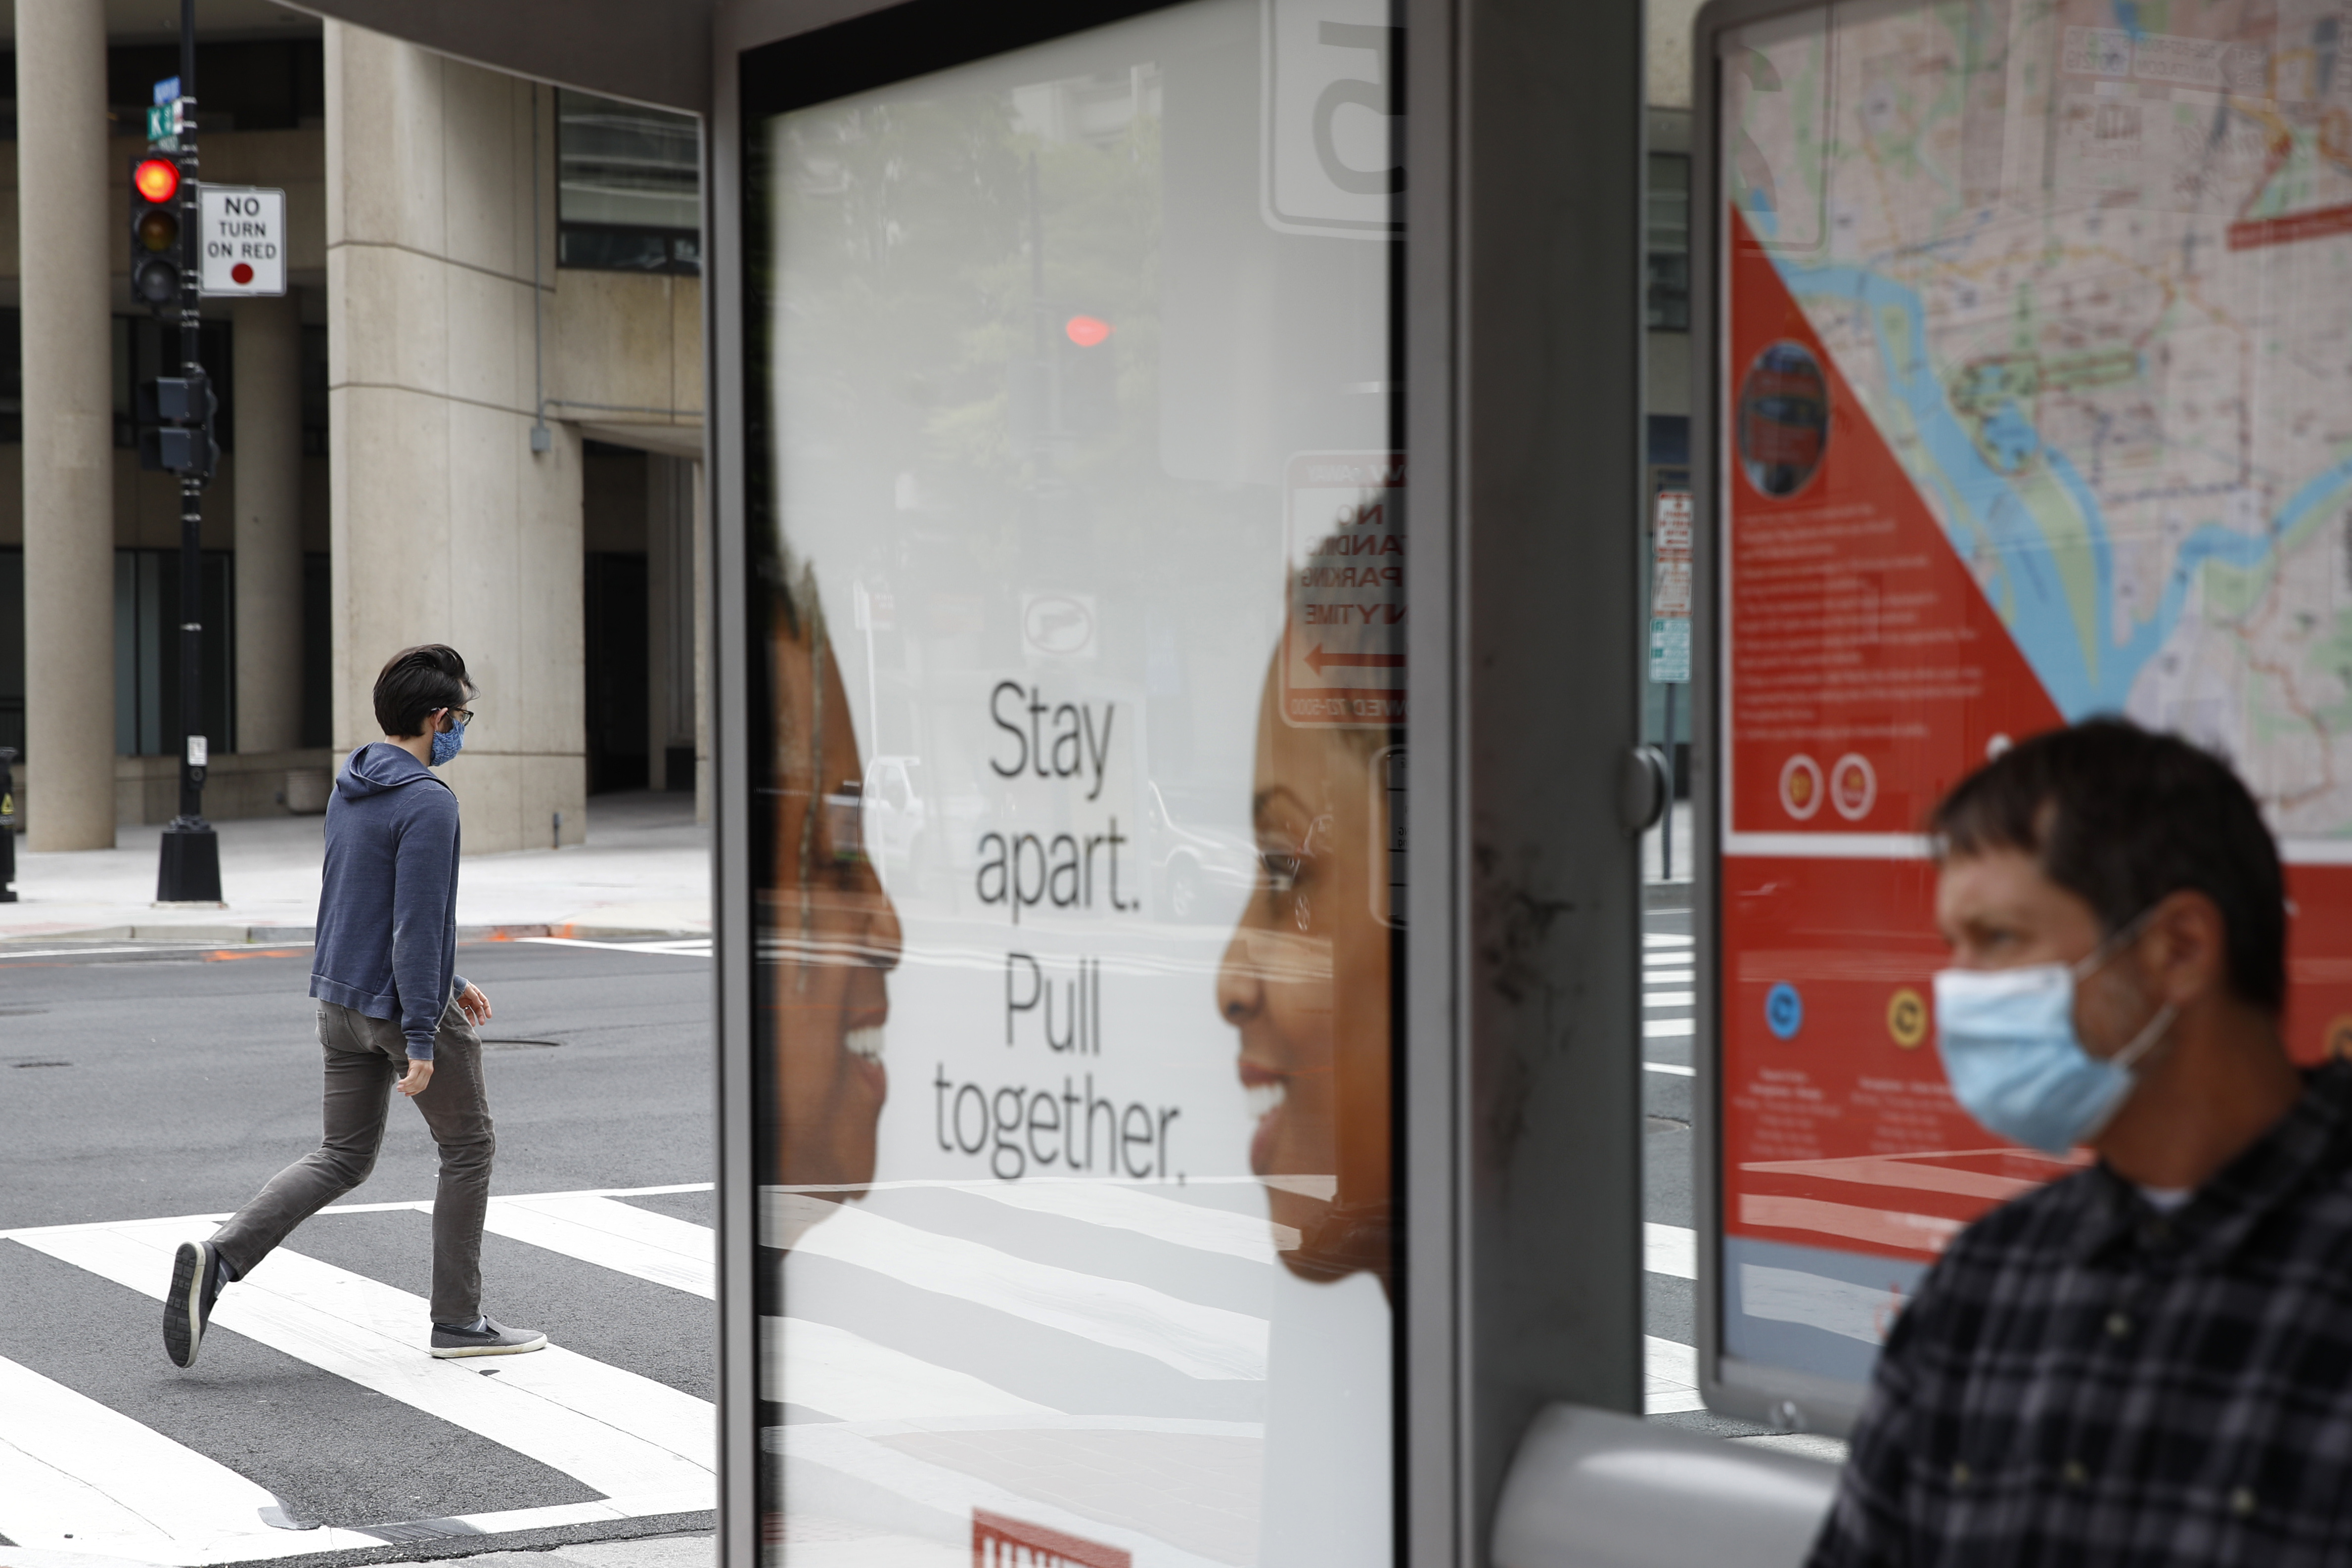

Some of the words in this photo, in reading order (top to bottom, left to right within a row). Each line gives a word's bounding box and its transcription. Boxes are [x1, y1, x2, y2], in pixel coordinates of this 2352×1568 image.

[207, 241, 232, 258] ON
[241, 242, 277, 259] RED
[219, 221, 266, 237] TURN
[225, 197, 260, 216] NO
[990, 680, 1114, 801] Stay
[976, 816, 1140, 925] apart.
[1006, 952, 1099, 1056] Pull
[933, 1062, 1186, 1186] together.
